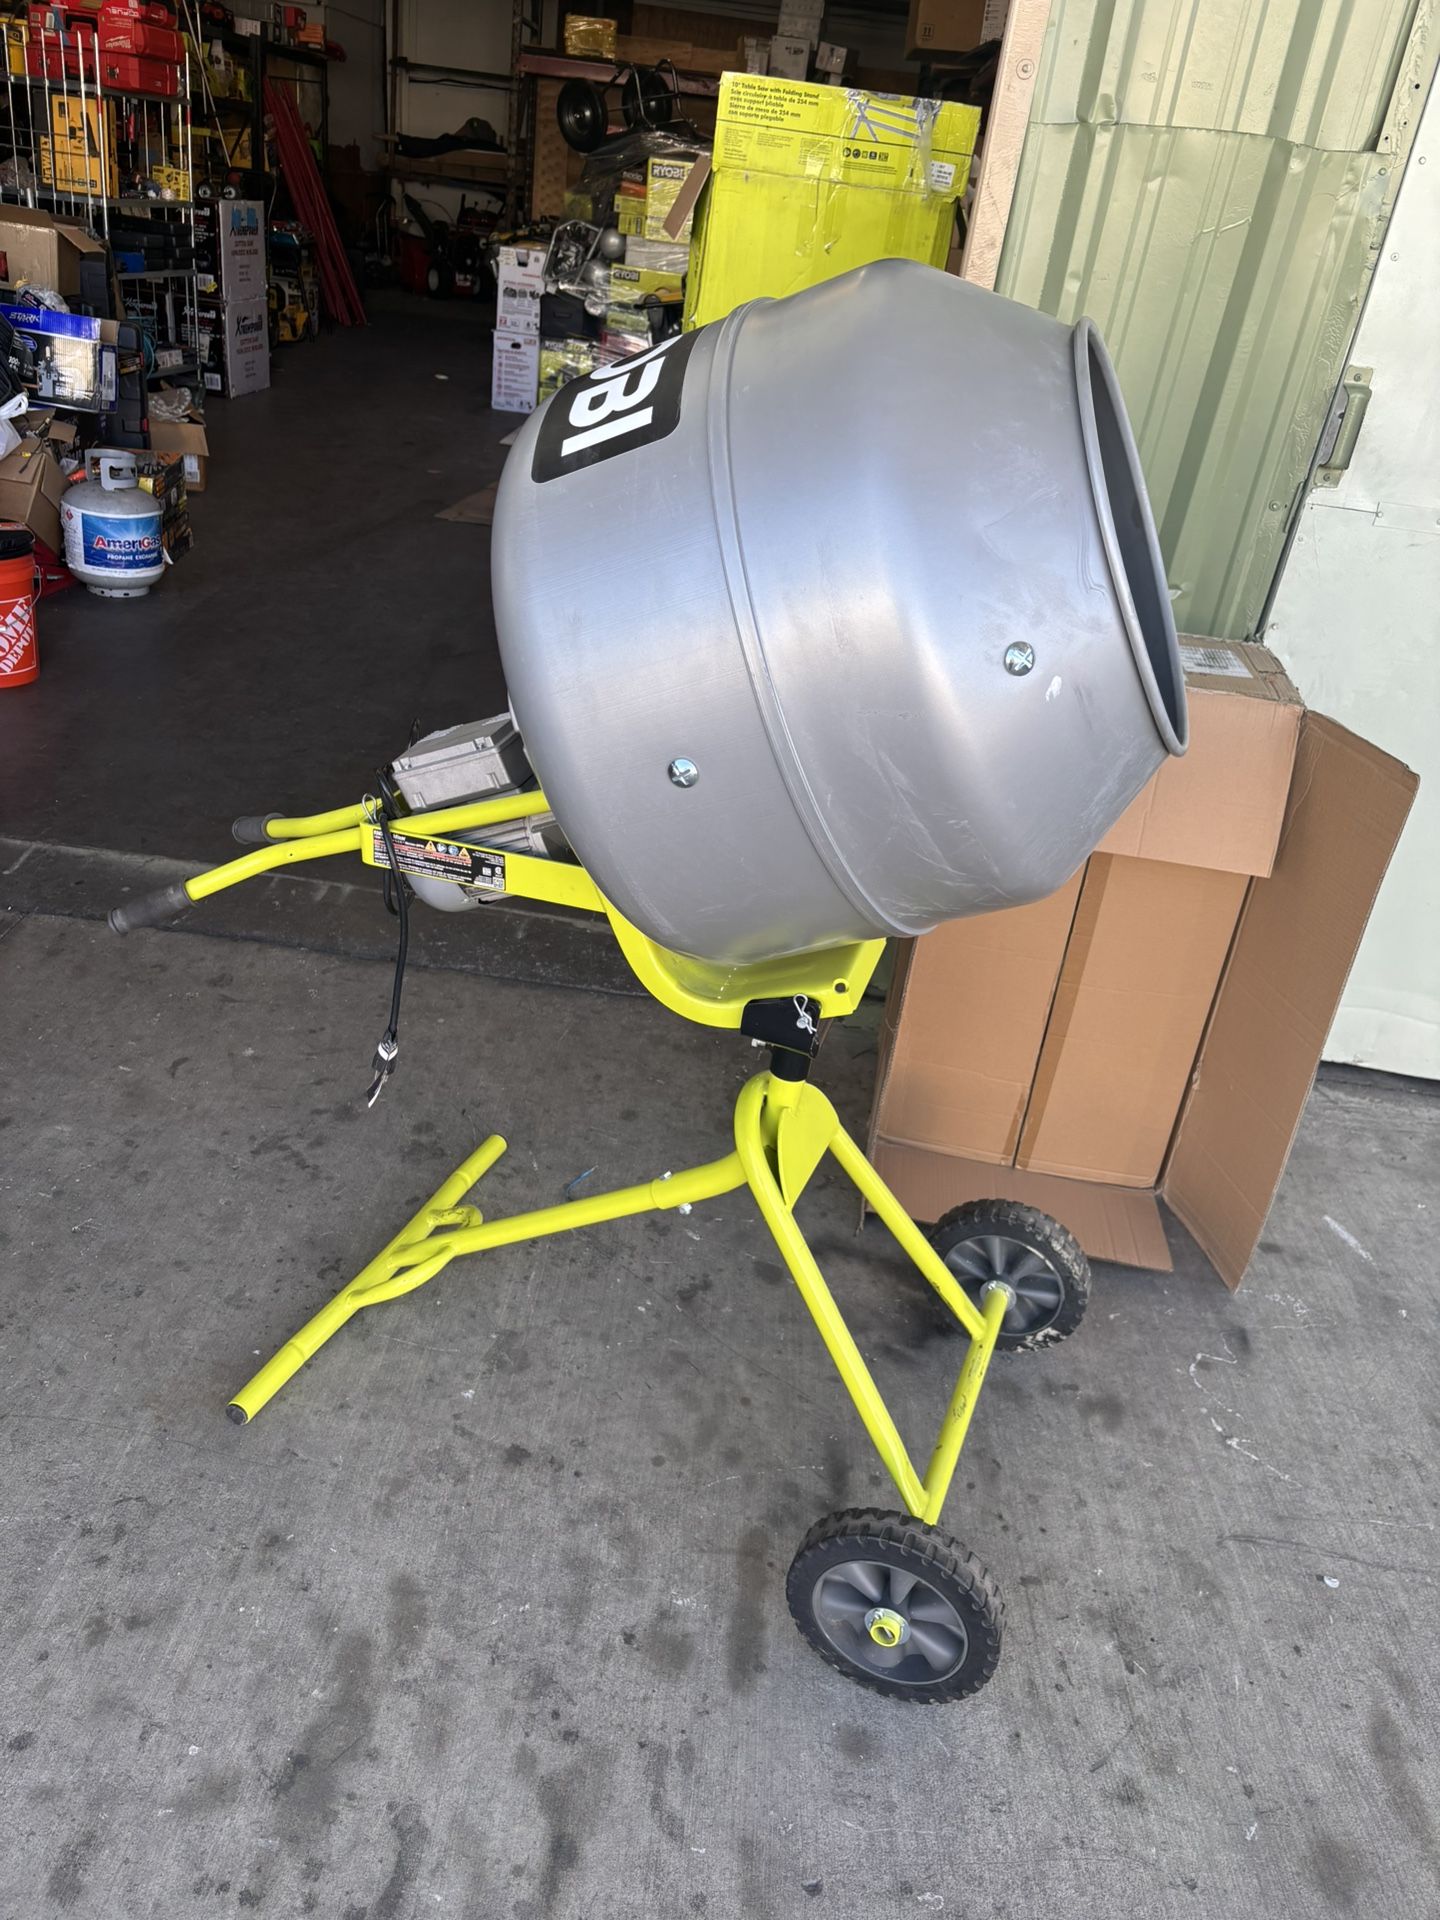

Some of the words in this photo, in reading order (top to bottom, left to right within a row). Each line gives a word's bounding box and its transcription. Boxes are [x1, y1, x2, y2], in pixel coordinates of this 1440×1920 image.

[783, 89, 803, 98] Folding
[743, 97, 765, 106] support
[765, 100, 784, 108] pliable
[739, 110, 760, 119] soporte
[760, 113, 784, 122] plegable
[94, 535, 161, 550] AmeriGas
[106, 553, 133, 561] PROPANE
